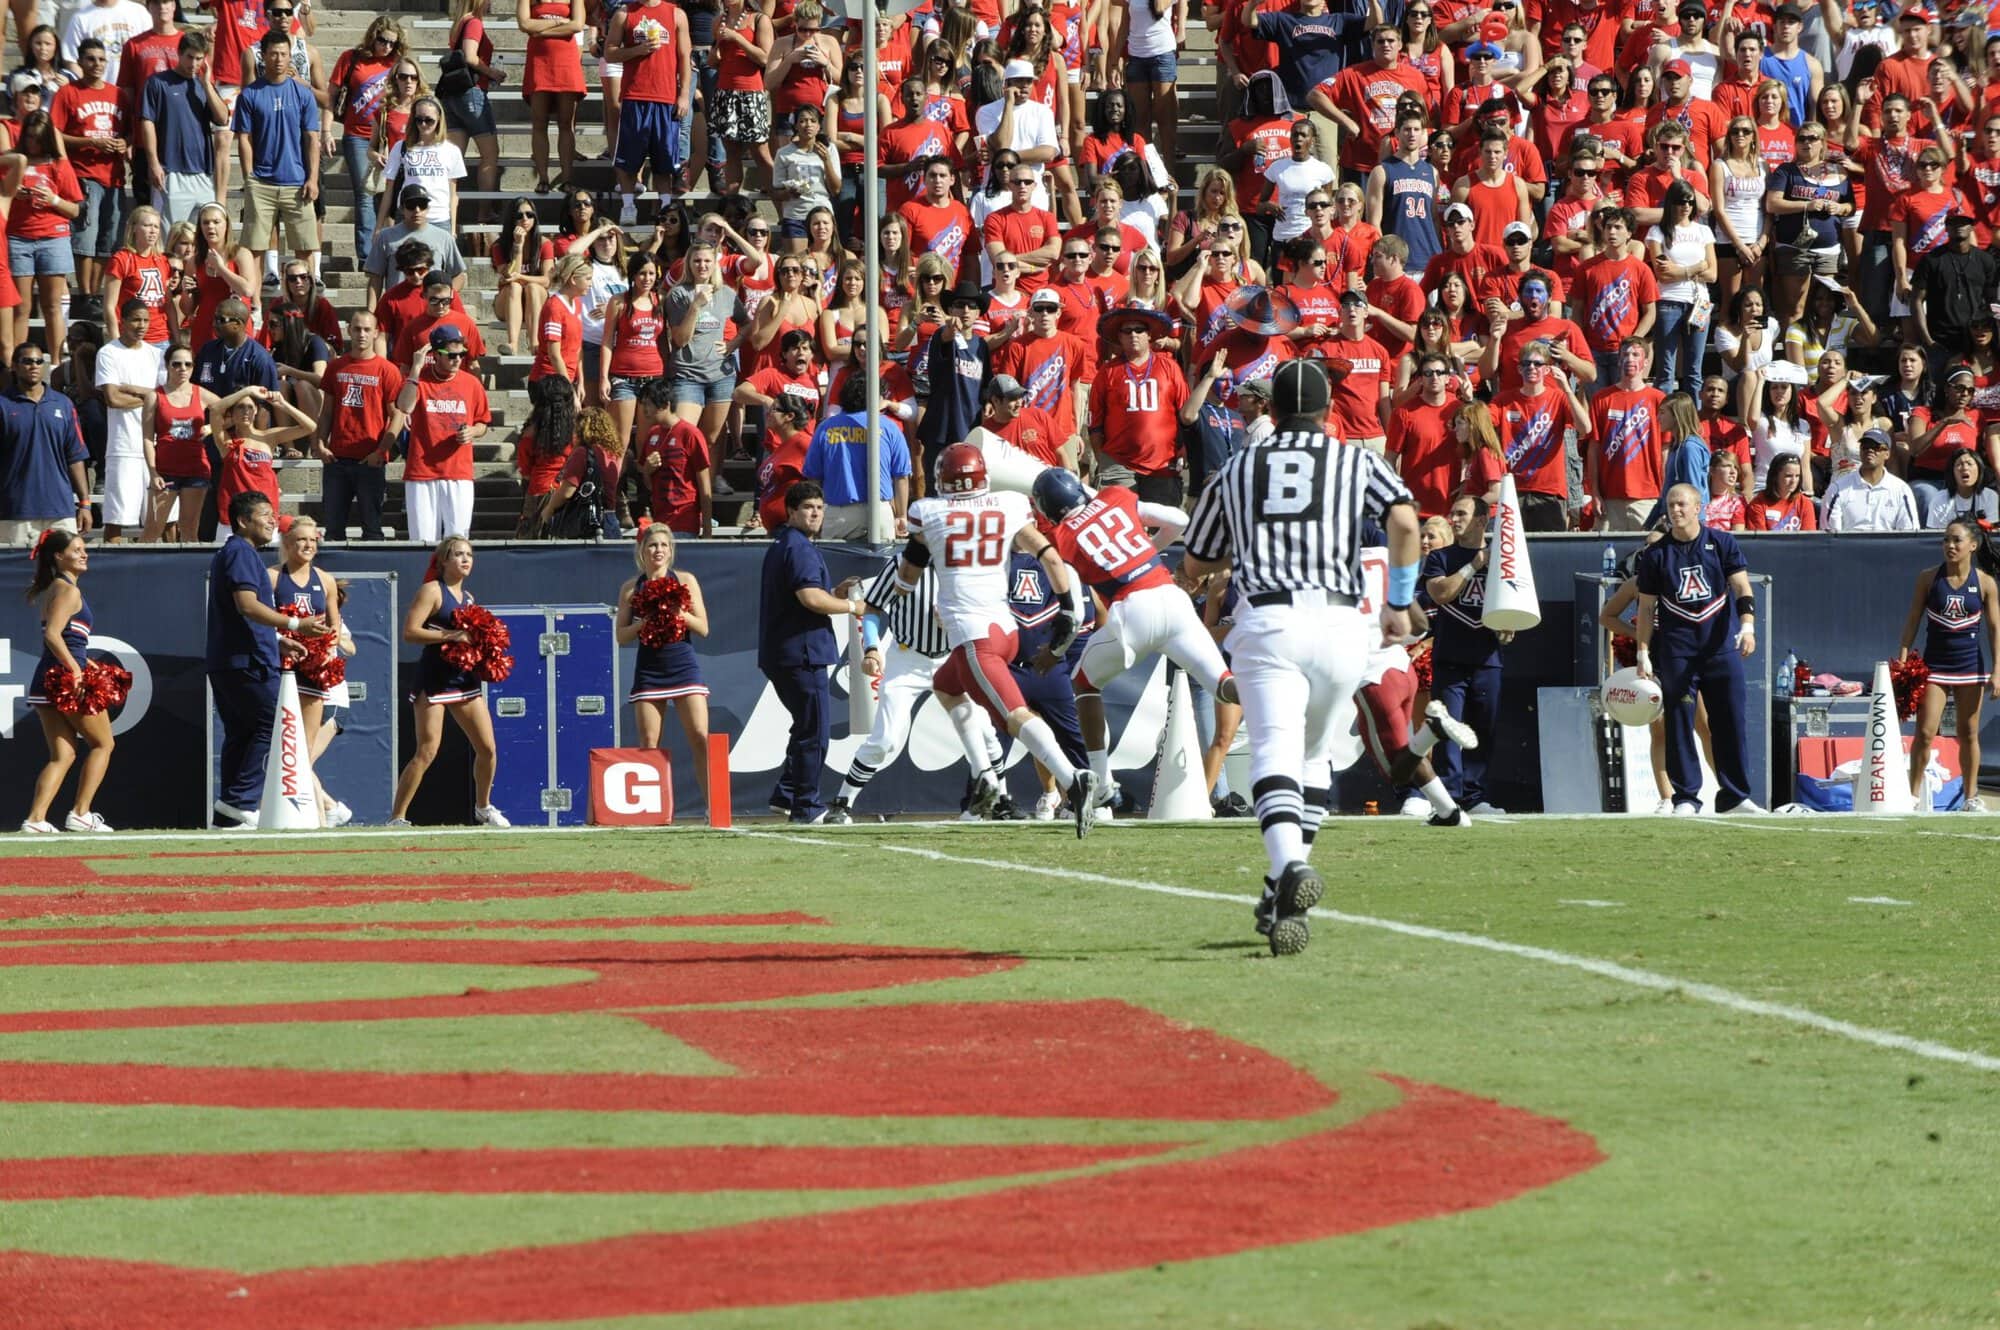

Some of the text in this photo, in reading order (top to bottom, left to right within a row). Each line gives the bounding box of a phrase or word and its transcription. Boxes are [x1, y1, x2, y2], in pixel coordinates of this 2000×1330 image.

[407, 151, 441, 167] UA
[407, 167, 444, 177] WILDCATS
[1393, 178, 1433, 199] ARIZONA
[1406, 196, 1427, 219] 34
[134, 269, 165, 301] A
[342, 385, 363, 407] A
[1125, 378, 1158, 411] 10
[826, 427, 883, 444] SECURI
[955, 477, 973, 491] 28
[1262, 451, 1316, 515] B
[947, 496, 1000, 508] MATTHEWS
[945, 510, 1005, 568] 28
[1077, 506, 1153, 571] 82
[1501, 503, 1516, 580] ARIZONA
[1009, 569, 1042, 603] A
[1675, 565, 1711, 603] A
[294, 593, 317, 617] A
[1942, 595, 1968, 619] A
[281, 705, 297, 797] ARIZONA
[1870, 692, 1887, 802] BEAR DOWN
[603, 761, 662, 815] G
